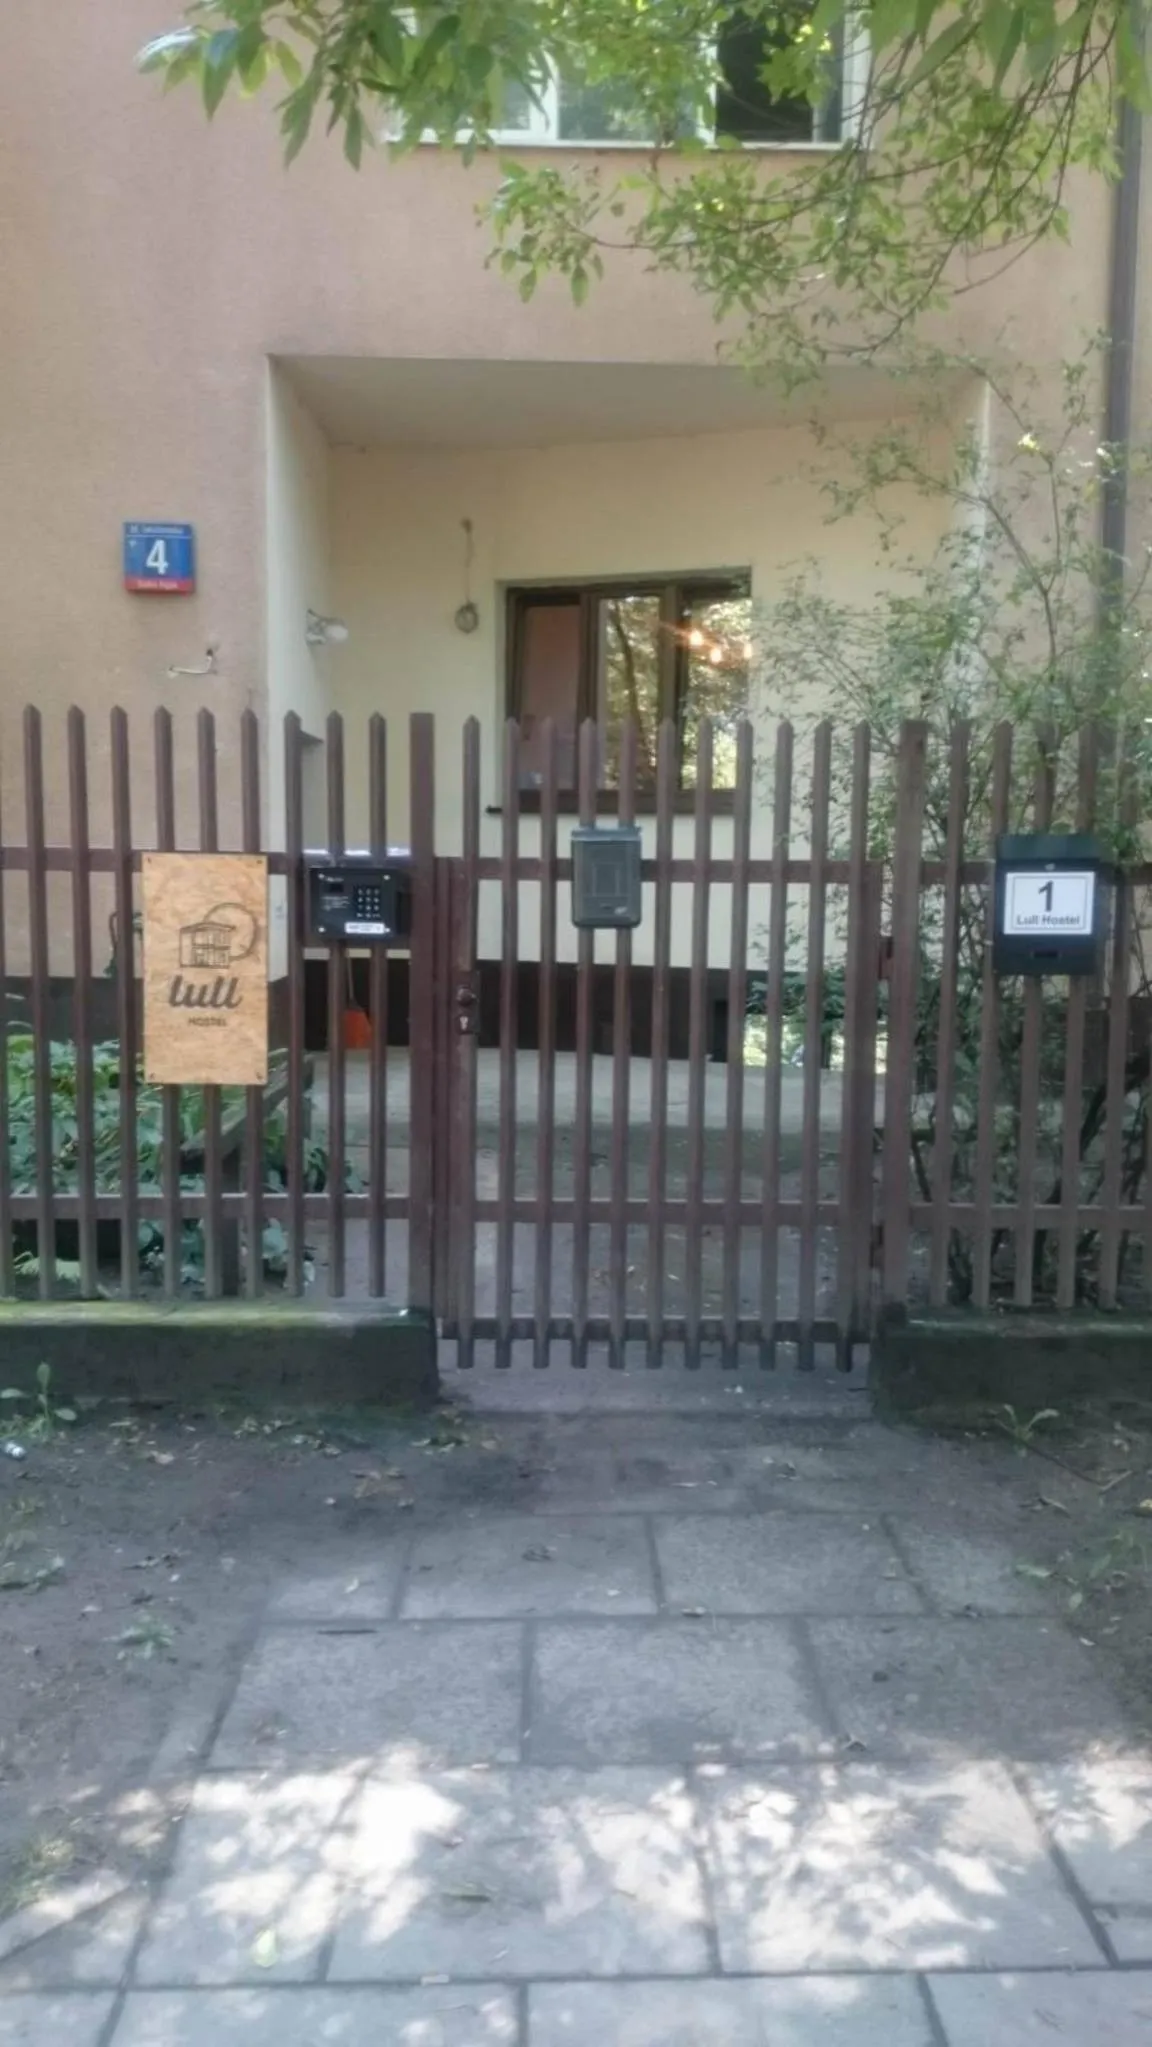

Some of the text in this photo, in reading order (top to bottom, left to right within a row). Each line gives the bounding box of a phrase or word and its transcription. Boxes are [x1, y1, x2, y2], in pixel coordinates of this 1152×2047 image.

[146, 539, 169, 575] 4
[1038, 880, 1054, 912] 1
[1042, 914, 1080, 925] Hostel
[187, 1016, 228, 1027] HOSTEL
